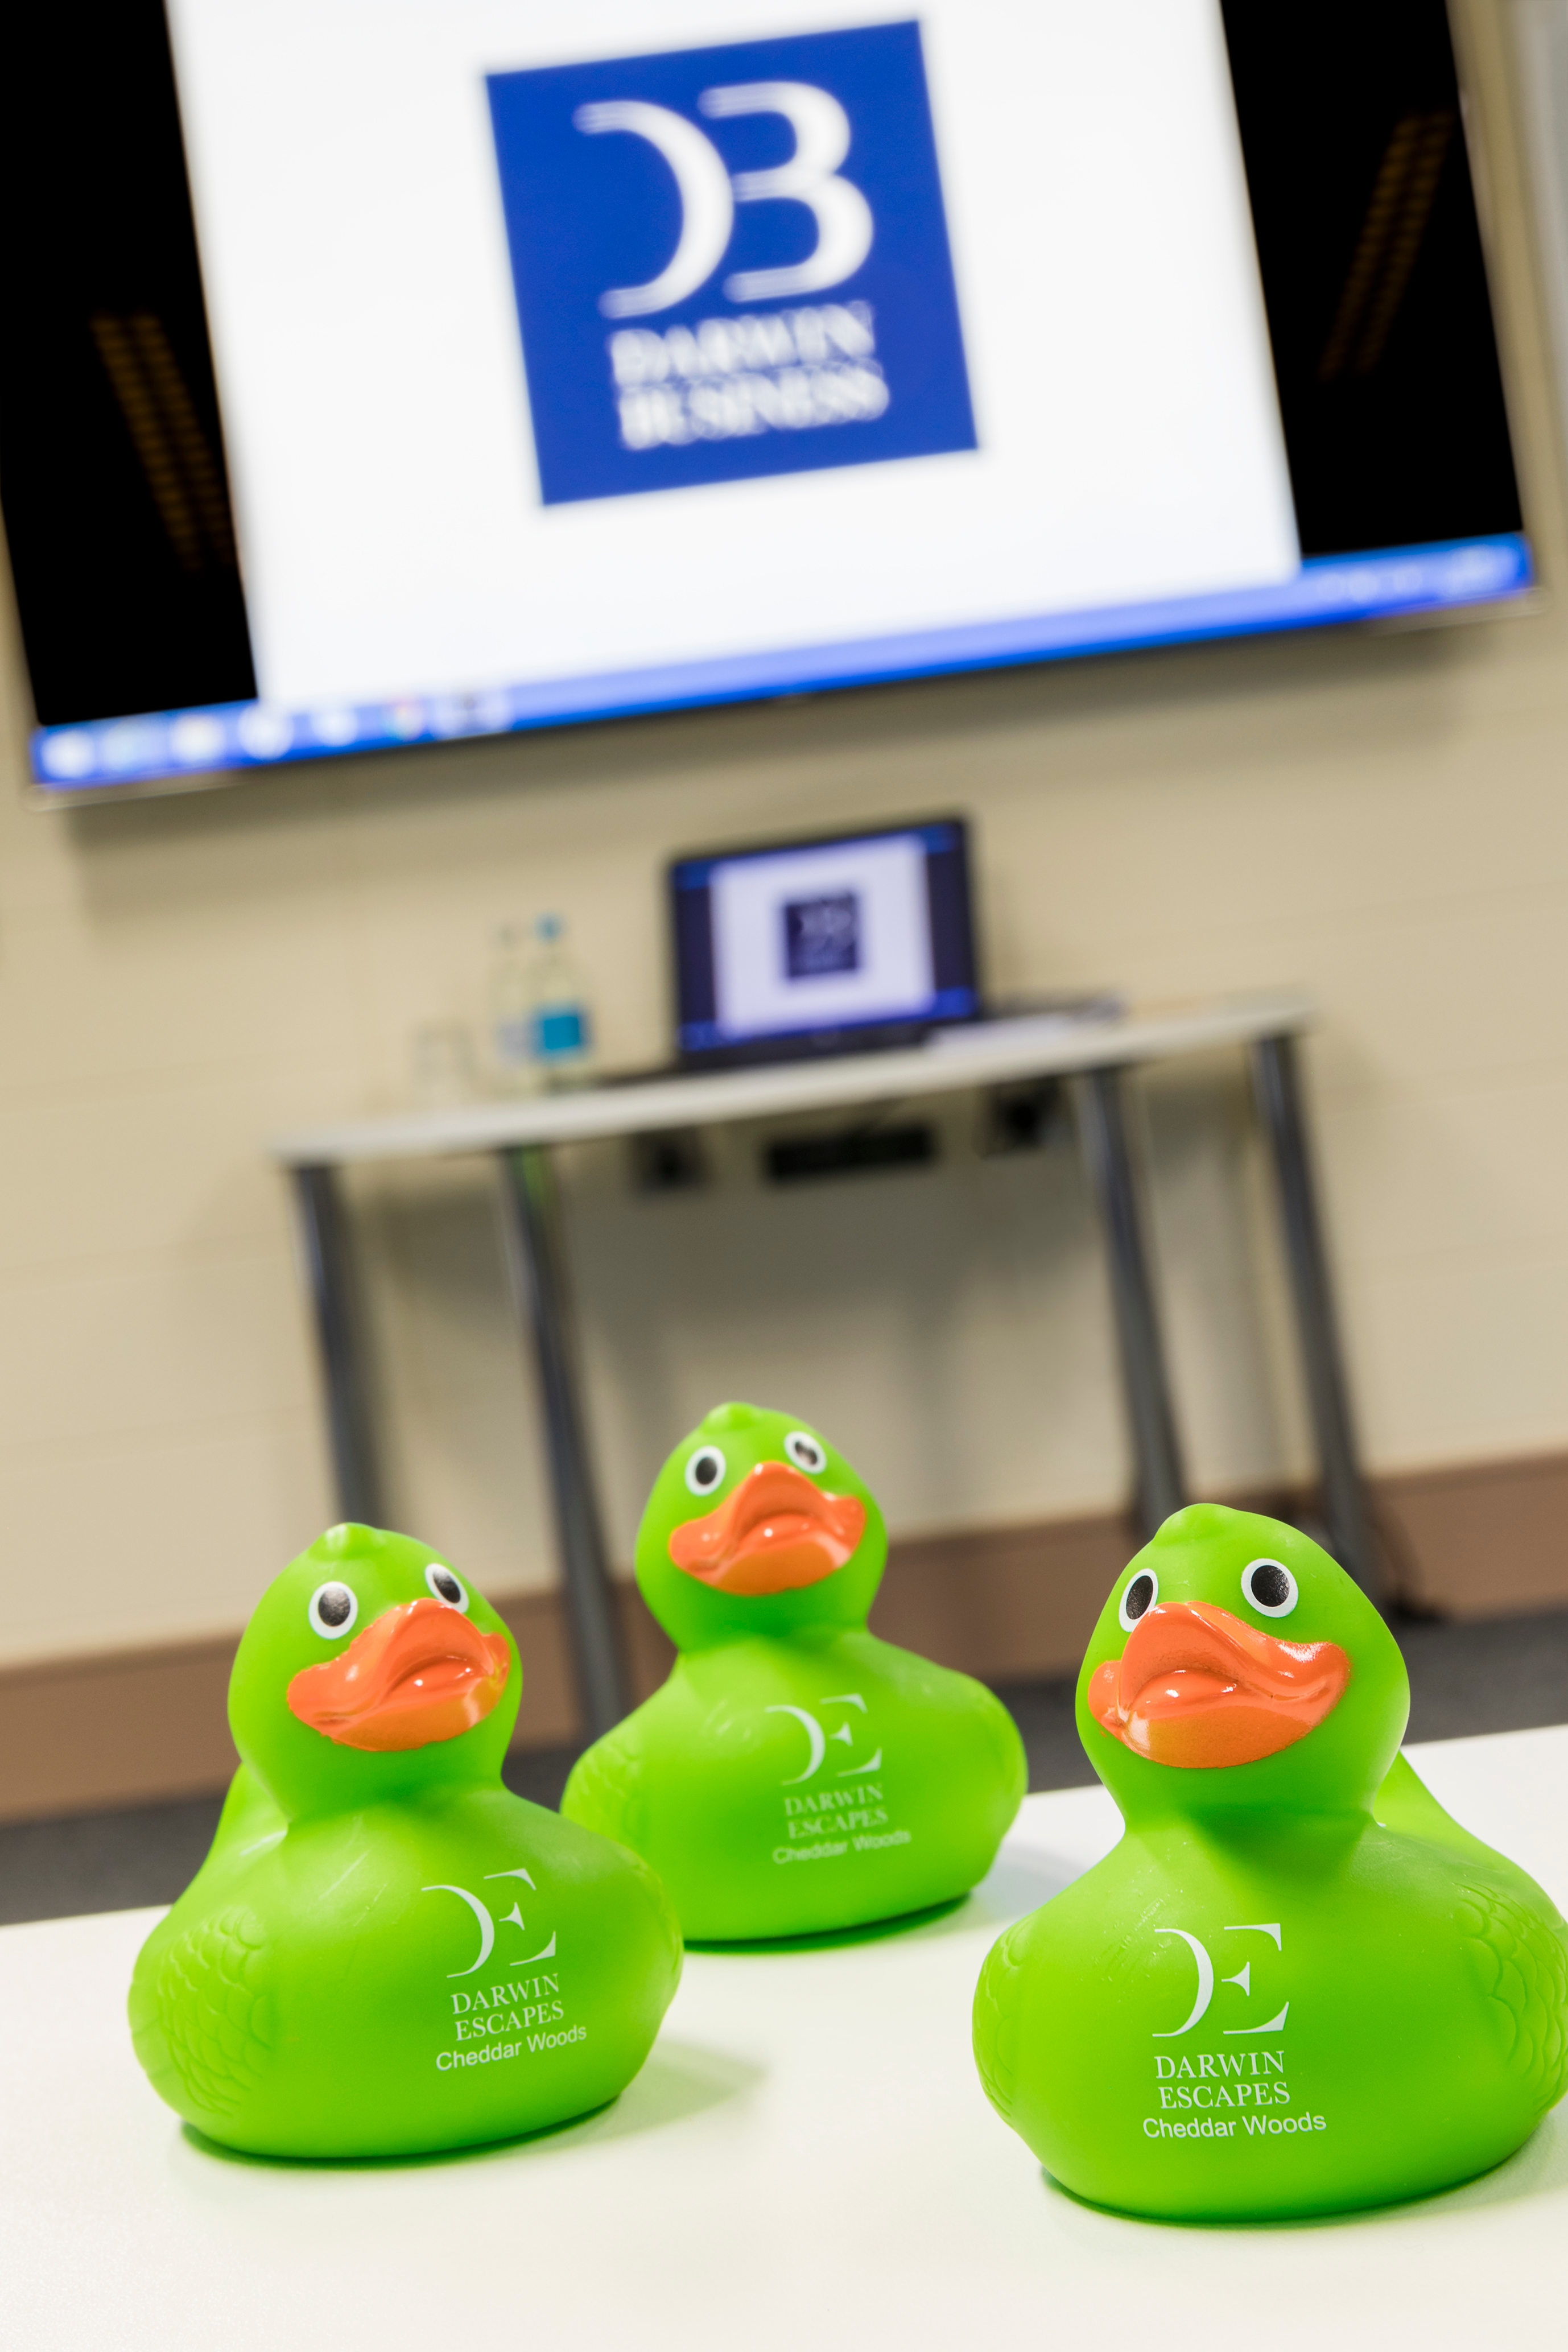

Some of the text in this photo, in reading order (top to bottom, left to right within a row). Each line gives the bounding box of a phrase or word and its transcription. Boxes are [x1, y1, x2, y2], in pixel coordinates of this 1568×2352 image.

[609, 300, 876, 386] DARWIN
[618, 357, 890, 451] BUSINESS
[784, 1783, 883, 1816] DARWIN
[787, 1808, 889, 1839] ESCAPES
[772, 1829, 911, 1864] Cheddar Woods
[450, 1973, 560, 2015] DARWIN
[455, 2000, 564, 2041] ESCAPES
[436, 2024, 587, 2071] Cheddar Woods
[1154, 2050, 1285, 2079] DARWIN
[1158, 2081, 1291, 2110] ESCAPES
[1143, 2111, 1327, 2138] Cheddar Woods
